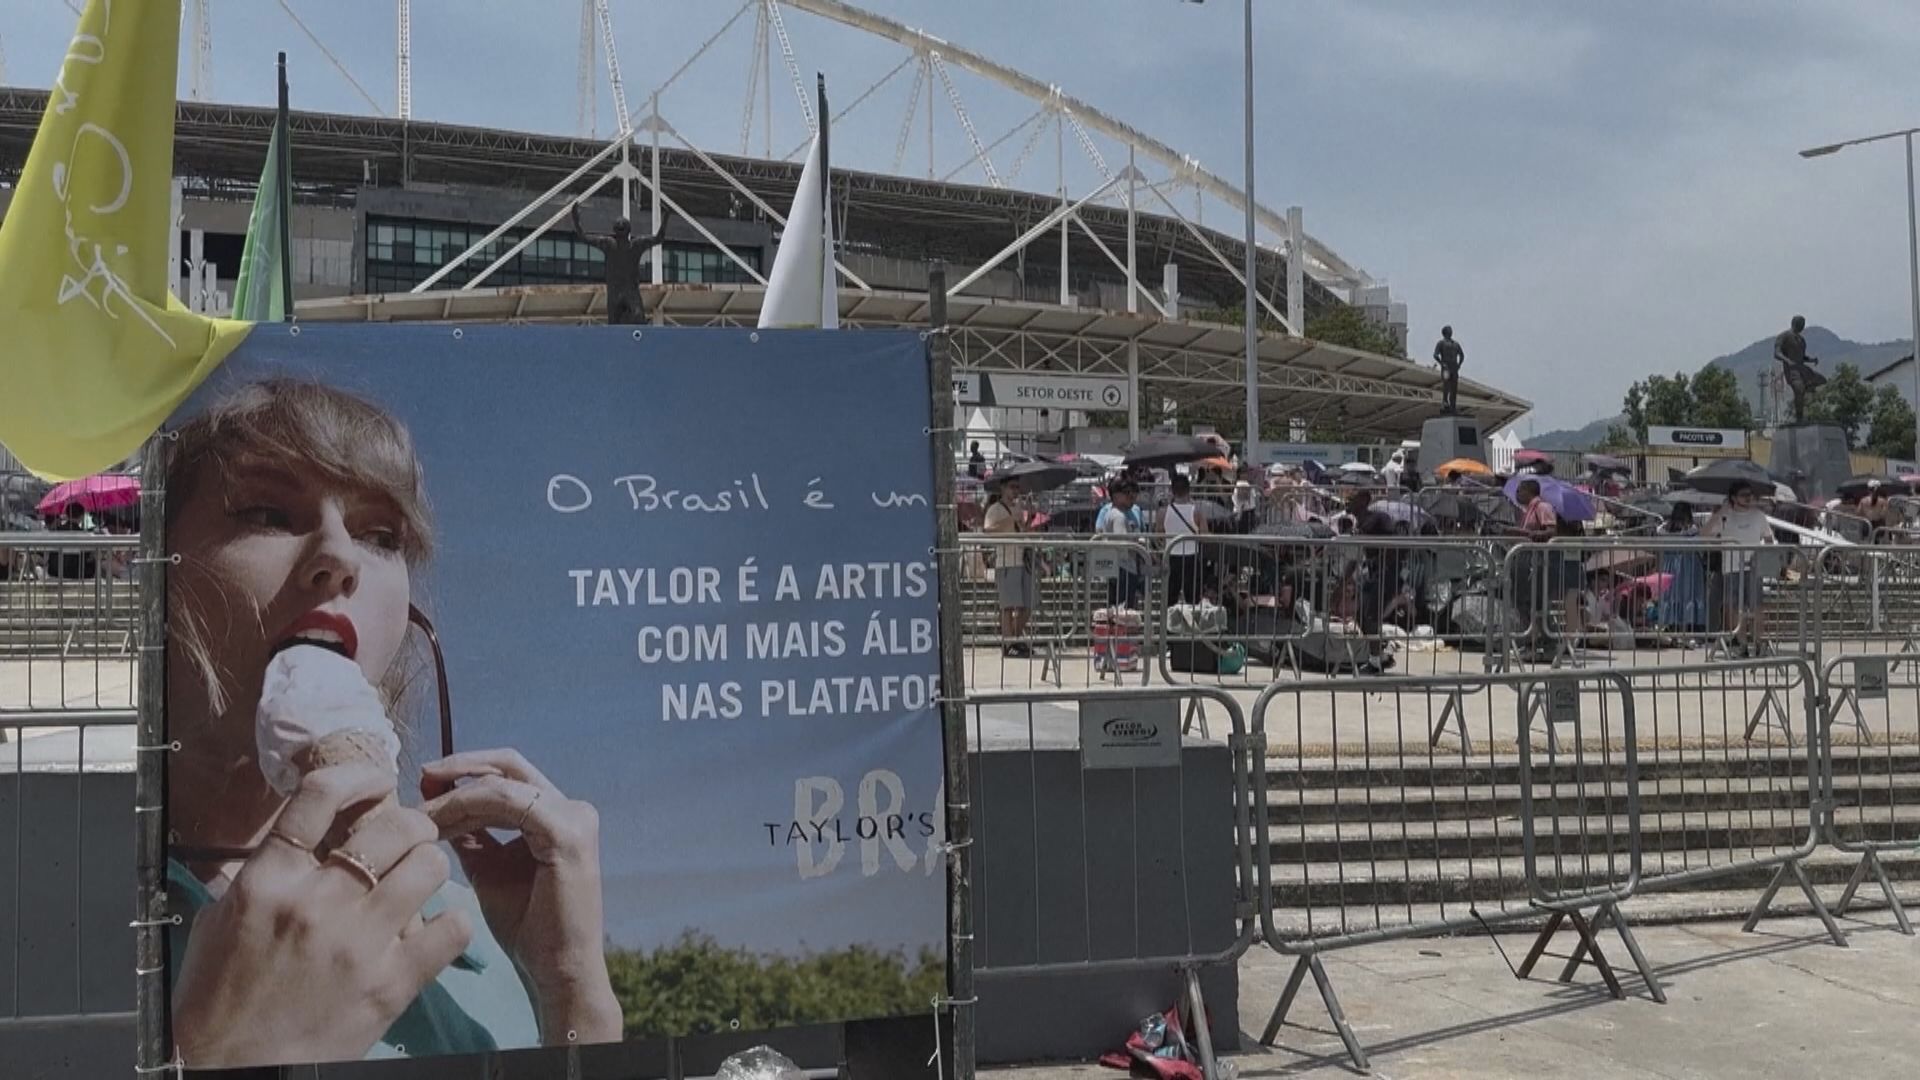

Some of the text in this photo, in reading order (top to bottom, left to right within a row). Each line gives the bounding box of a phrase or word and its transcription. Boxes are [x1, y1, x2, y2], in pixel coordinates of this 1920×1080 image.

[1017, 386, 1093, 401] SETOR OESTE
[1679, 433, 1704, 441] PACOTE
[548, 473, 927, 512] O Brasil é um
[568, 557, 938, 607] TAYLOR É A ARTIS
[637, 610, 940, 664] COM MAIS ÁLB
[662, 681, 743, 721] NAS
[763, 812, 935, 846] TAYLOR'S
